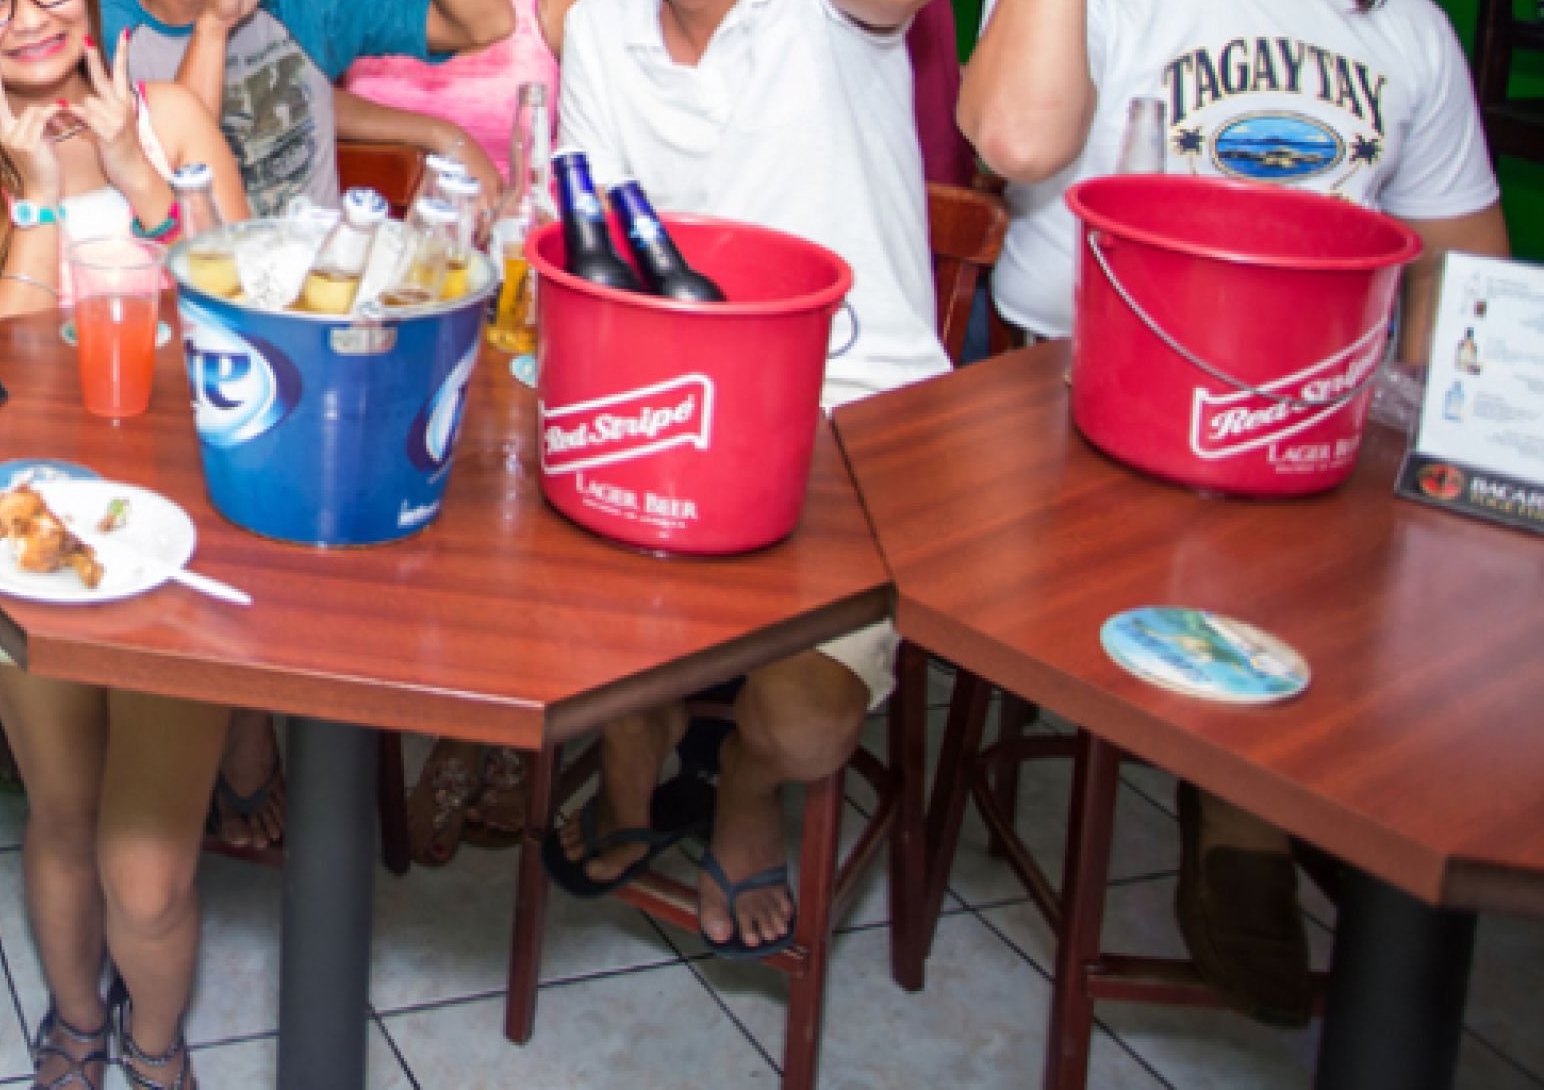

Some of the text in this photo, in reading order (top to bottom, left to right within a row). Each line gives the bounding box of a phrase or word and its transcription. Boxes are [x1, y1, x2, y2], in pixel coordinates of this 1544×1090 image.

[1160, 35, 1389, 140] TAGAYTAY
[591, 394, 696, 441] Stripe
[575, 470, 638, 510] LAGER
[644, 491, 699, 520] BEER
